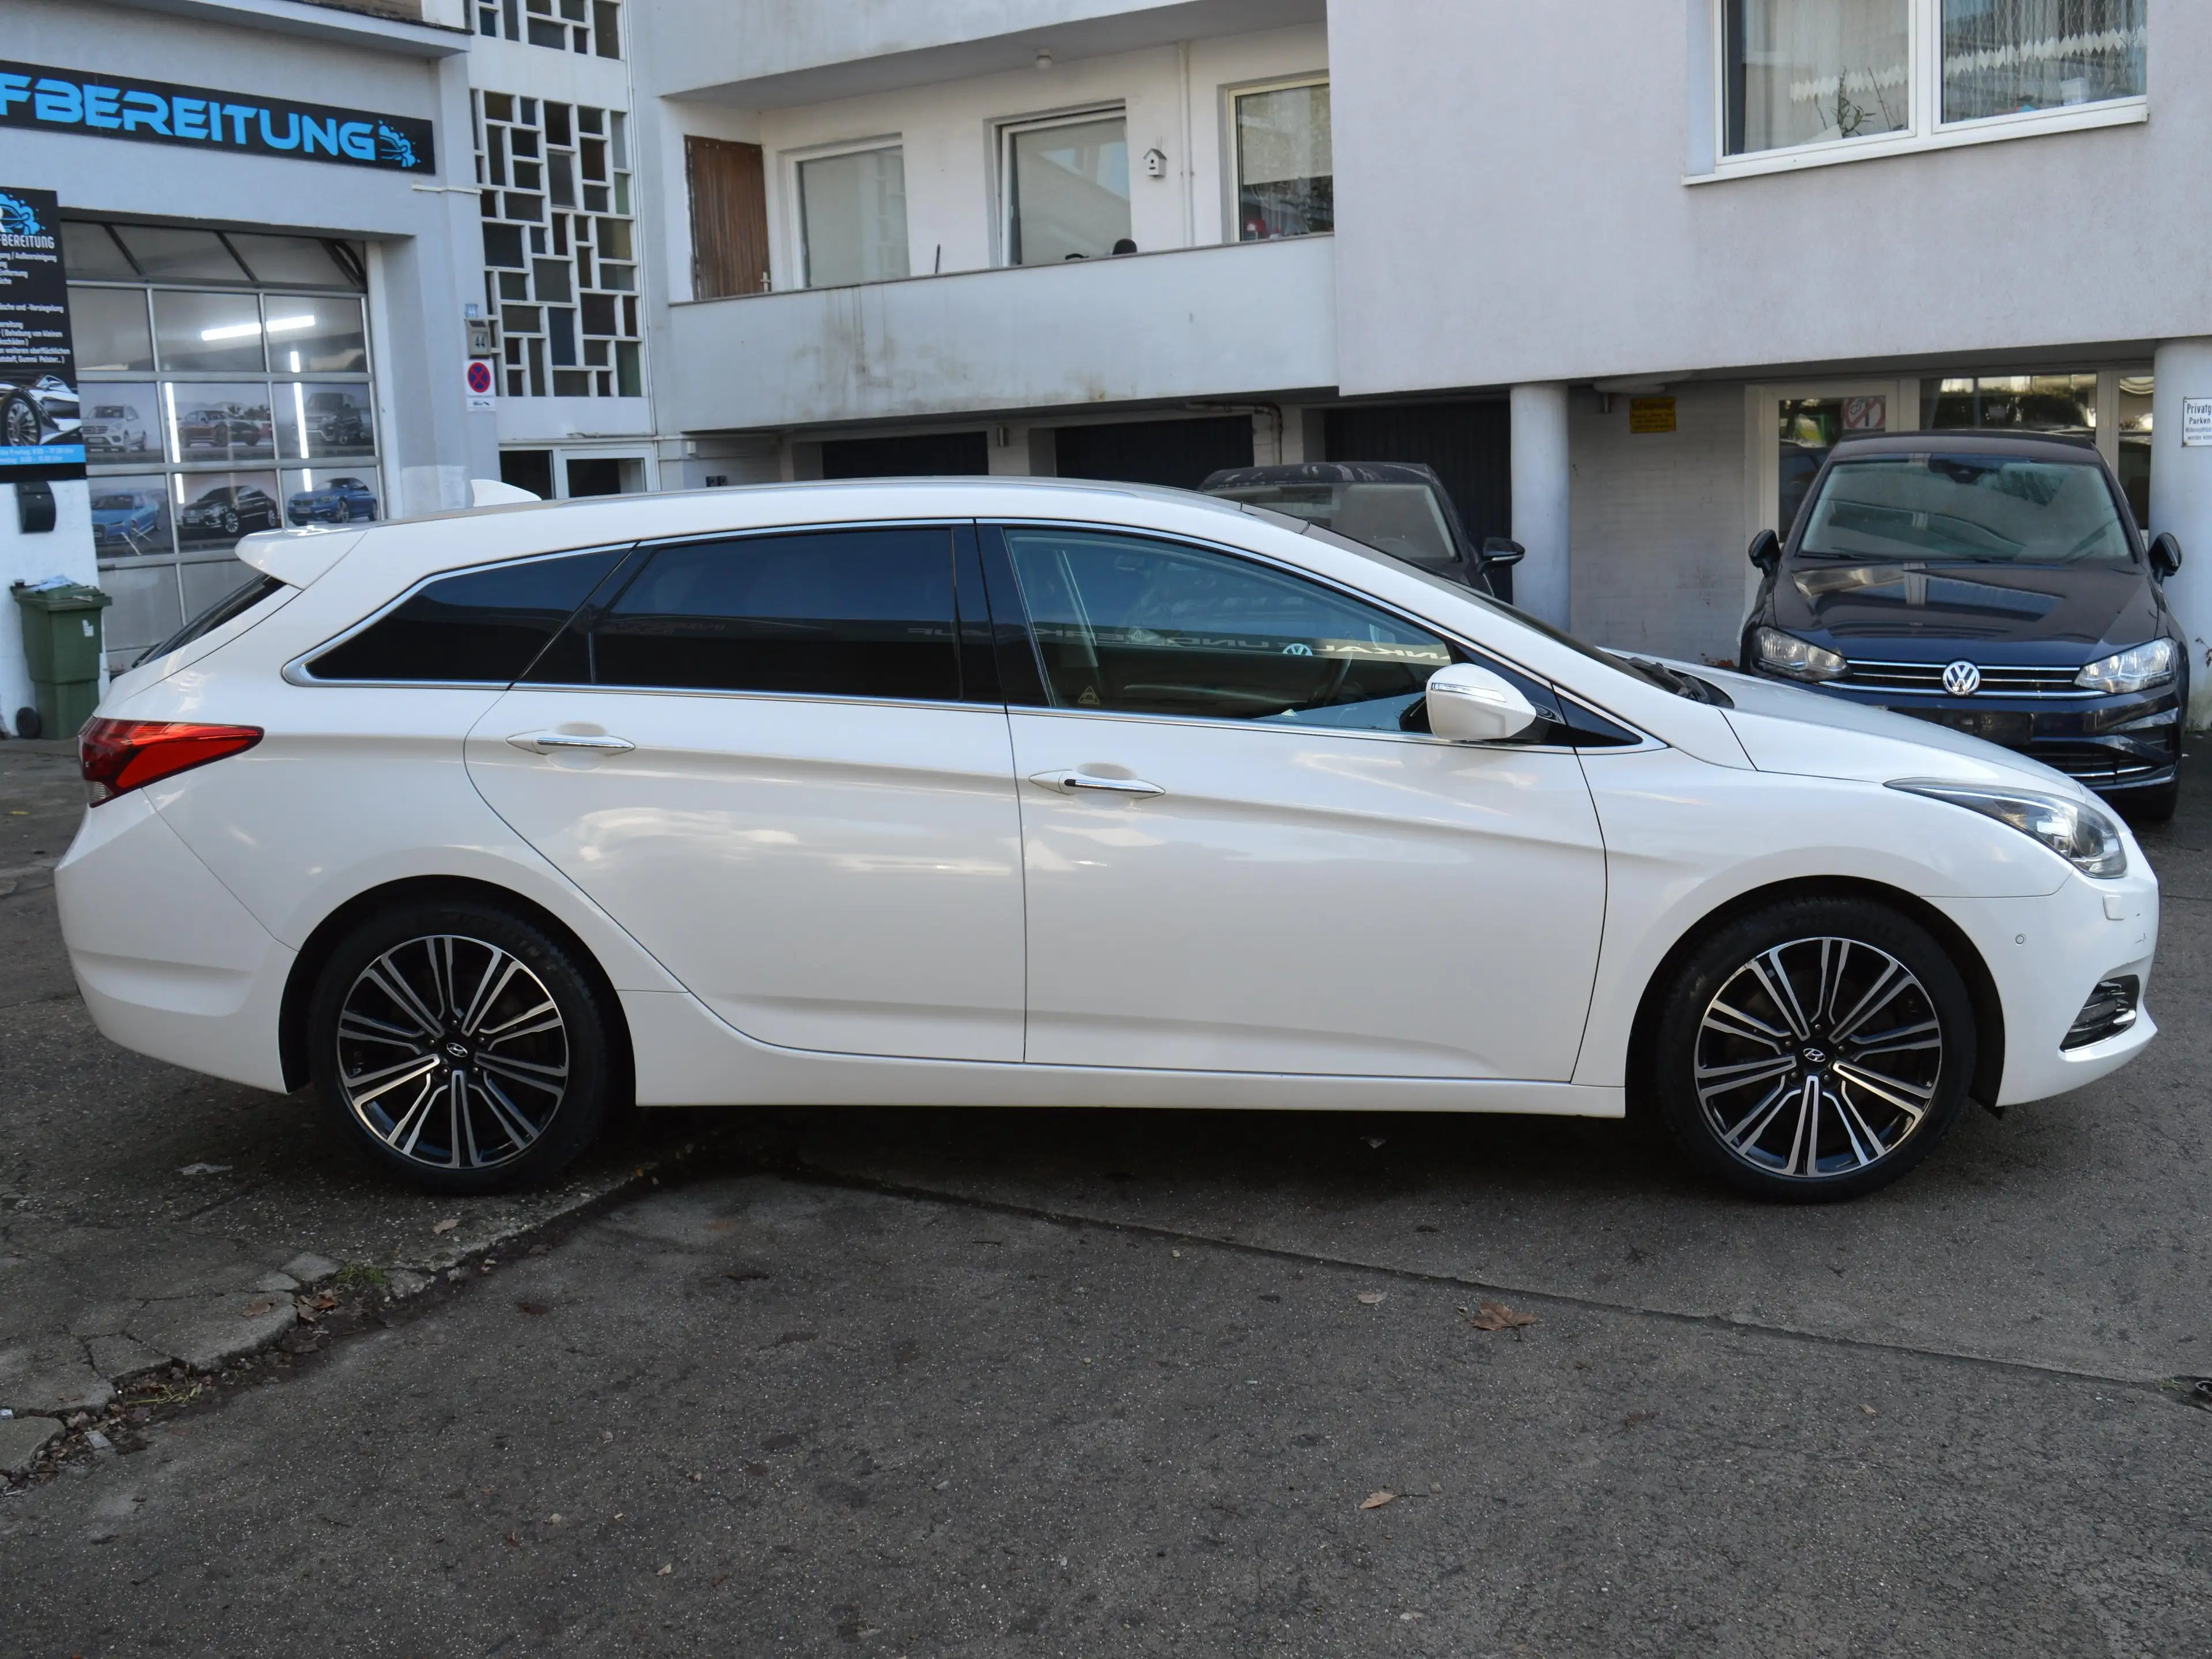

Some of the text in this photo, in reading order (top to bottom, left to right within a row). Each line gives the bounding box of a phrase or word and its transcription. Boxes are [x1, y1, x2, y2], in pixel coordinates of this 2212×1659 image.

[0, 234, 55, 249] BEREITUNG
[475, 335, 486, 349] 44
[2187, 403, 2212, 415] Privatg
[2189, 416, 2211, 425] Parken
[1943, 661, 1980, 696] VW
